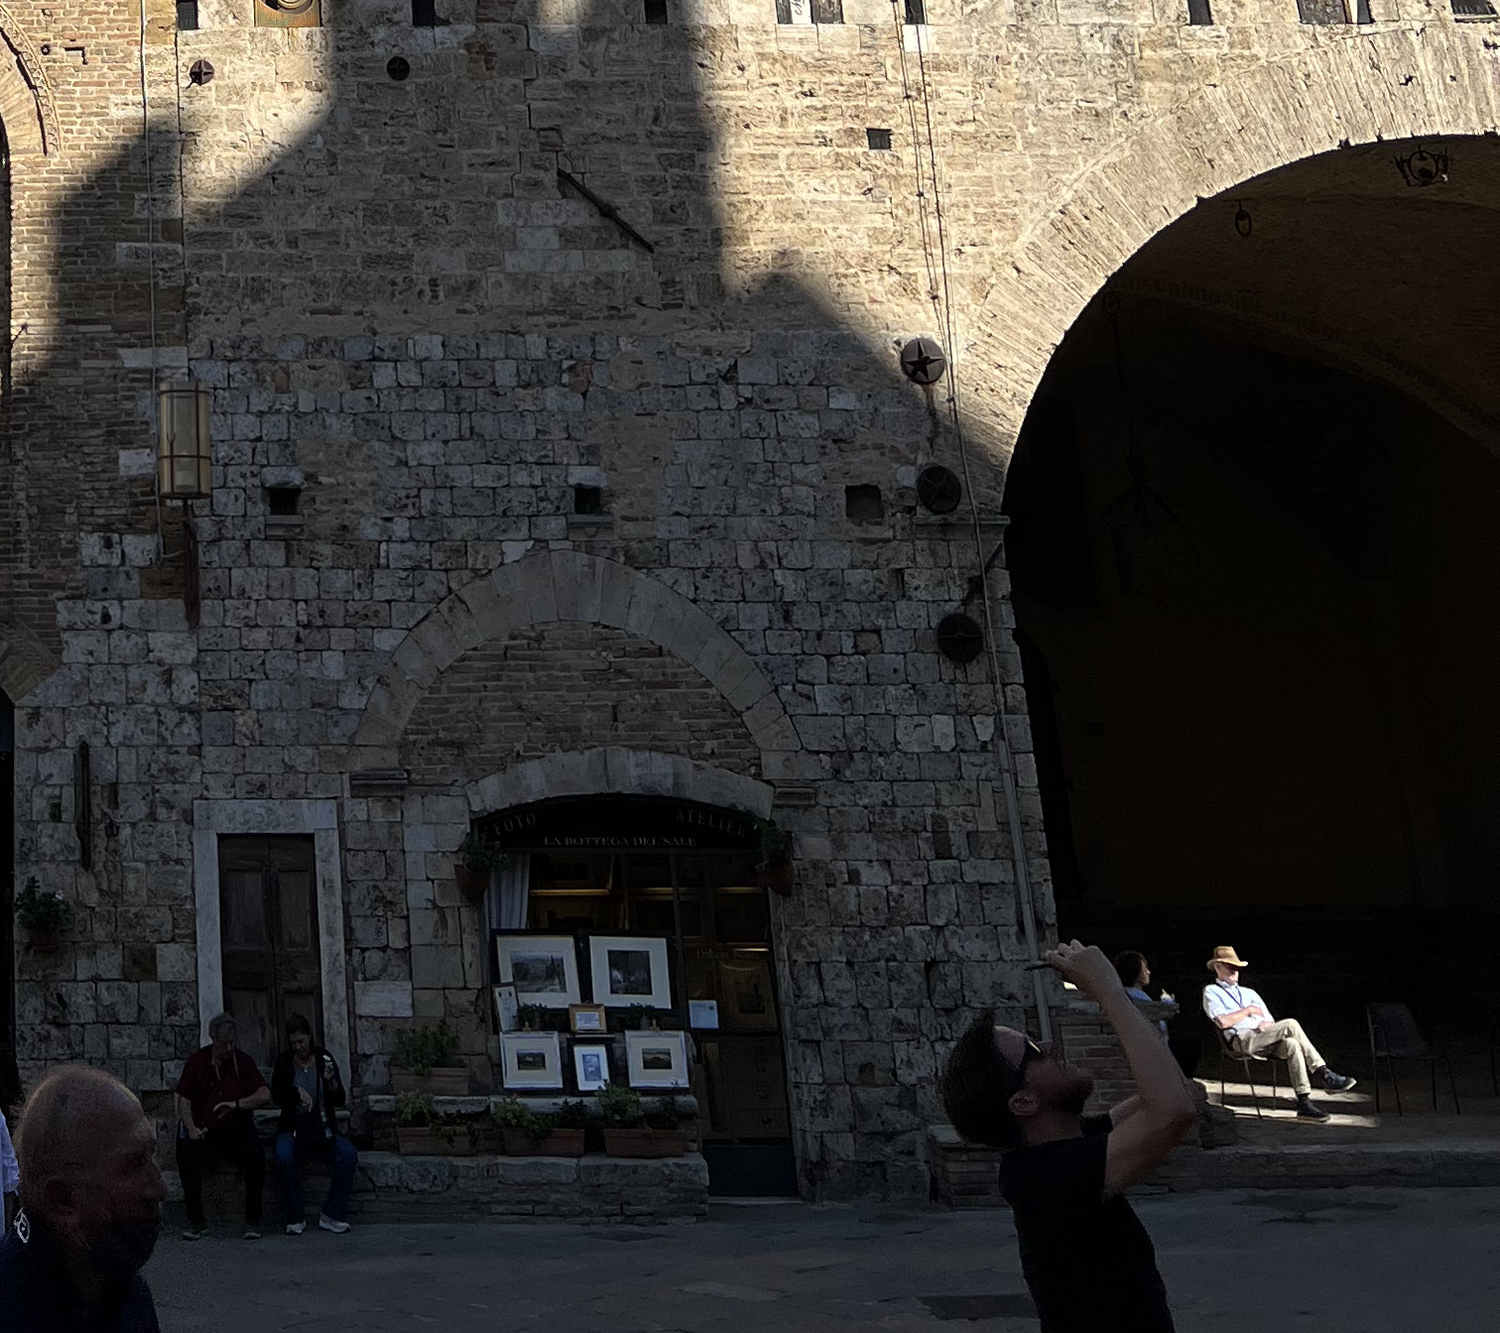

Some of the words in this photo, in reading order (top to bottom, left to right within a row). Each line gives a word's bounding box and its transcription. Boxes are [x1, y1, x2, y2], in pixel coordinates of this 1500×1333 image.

[543, 836, 562, 847] LA
[565, 836, 630, 847] BOTTEGA
[633, 836, 657, 847] DEL
